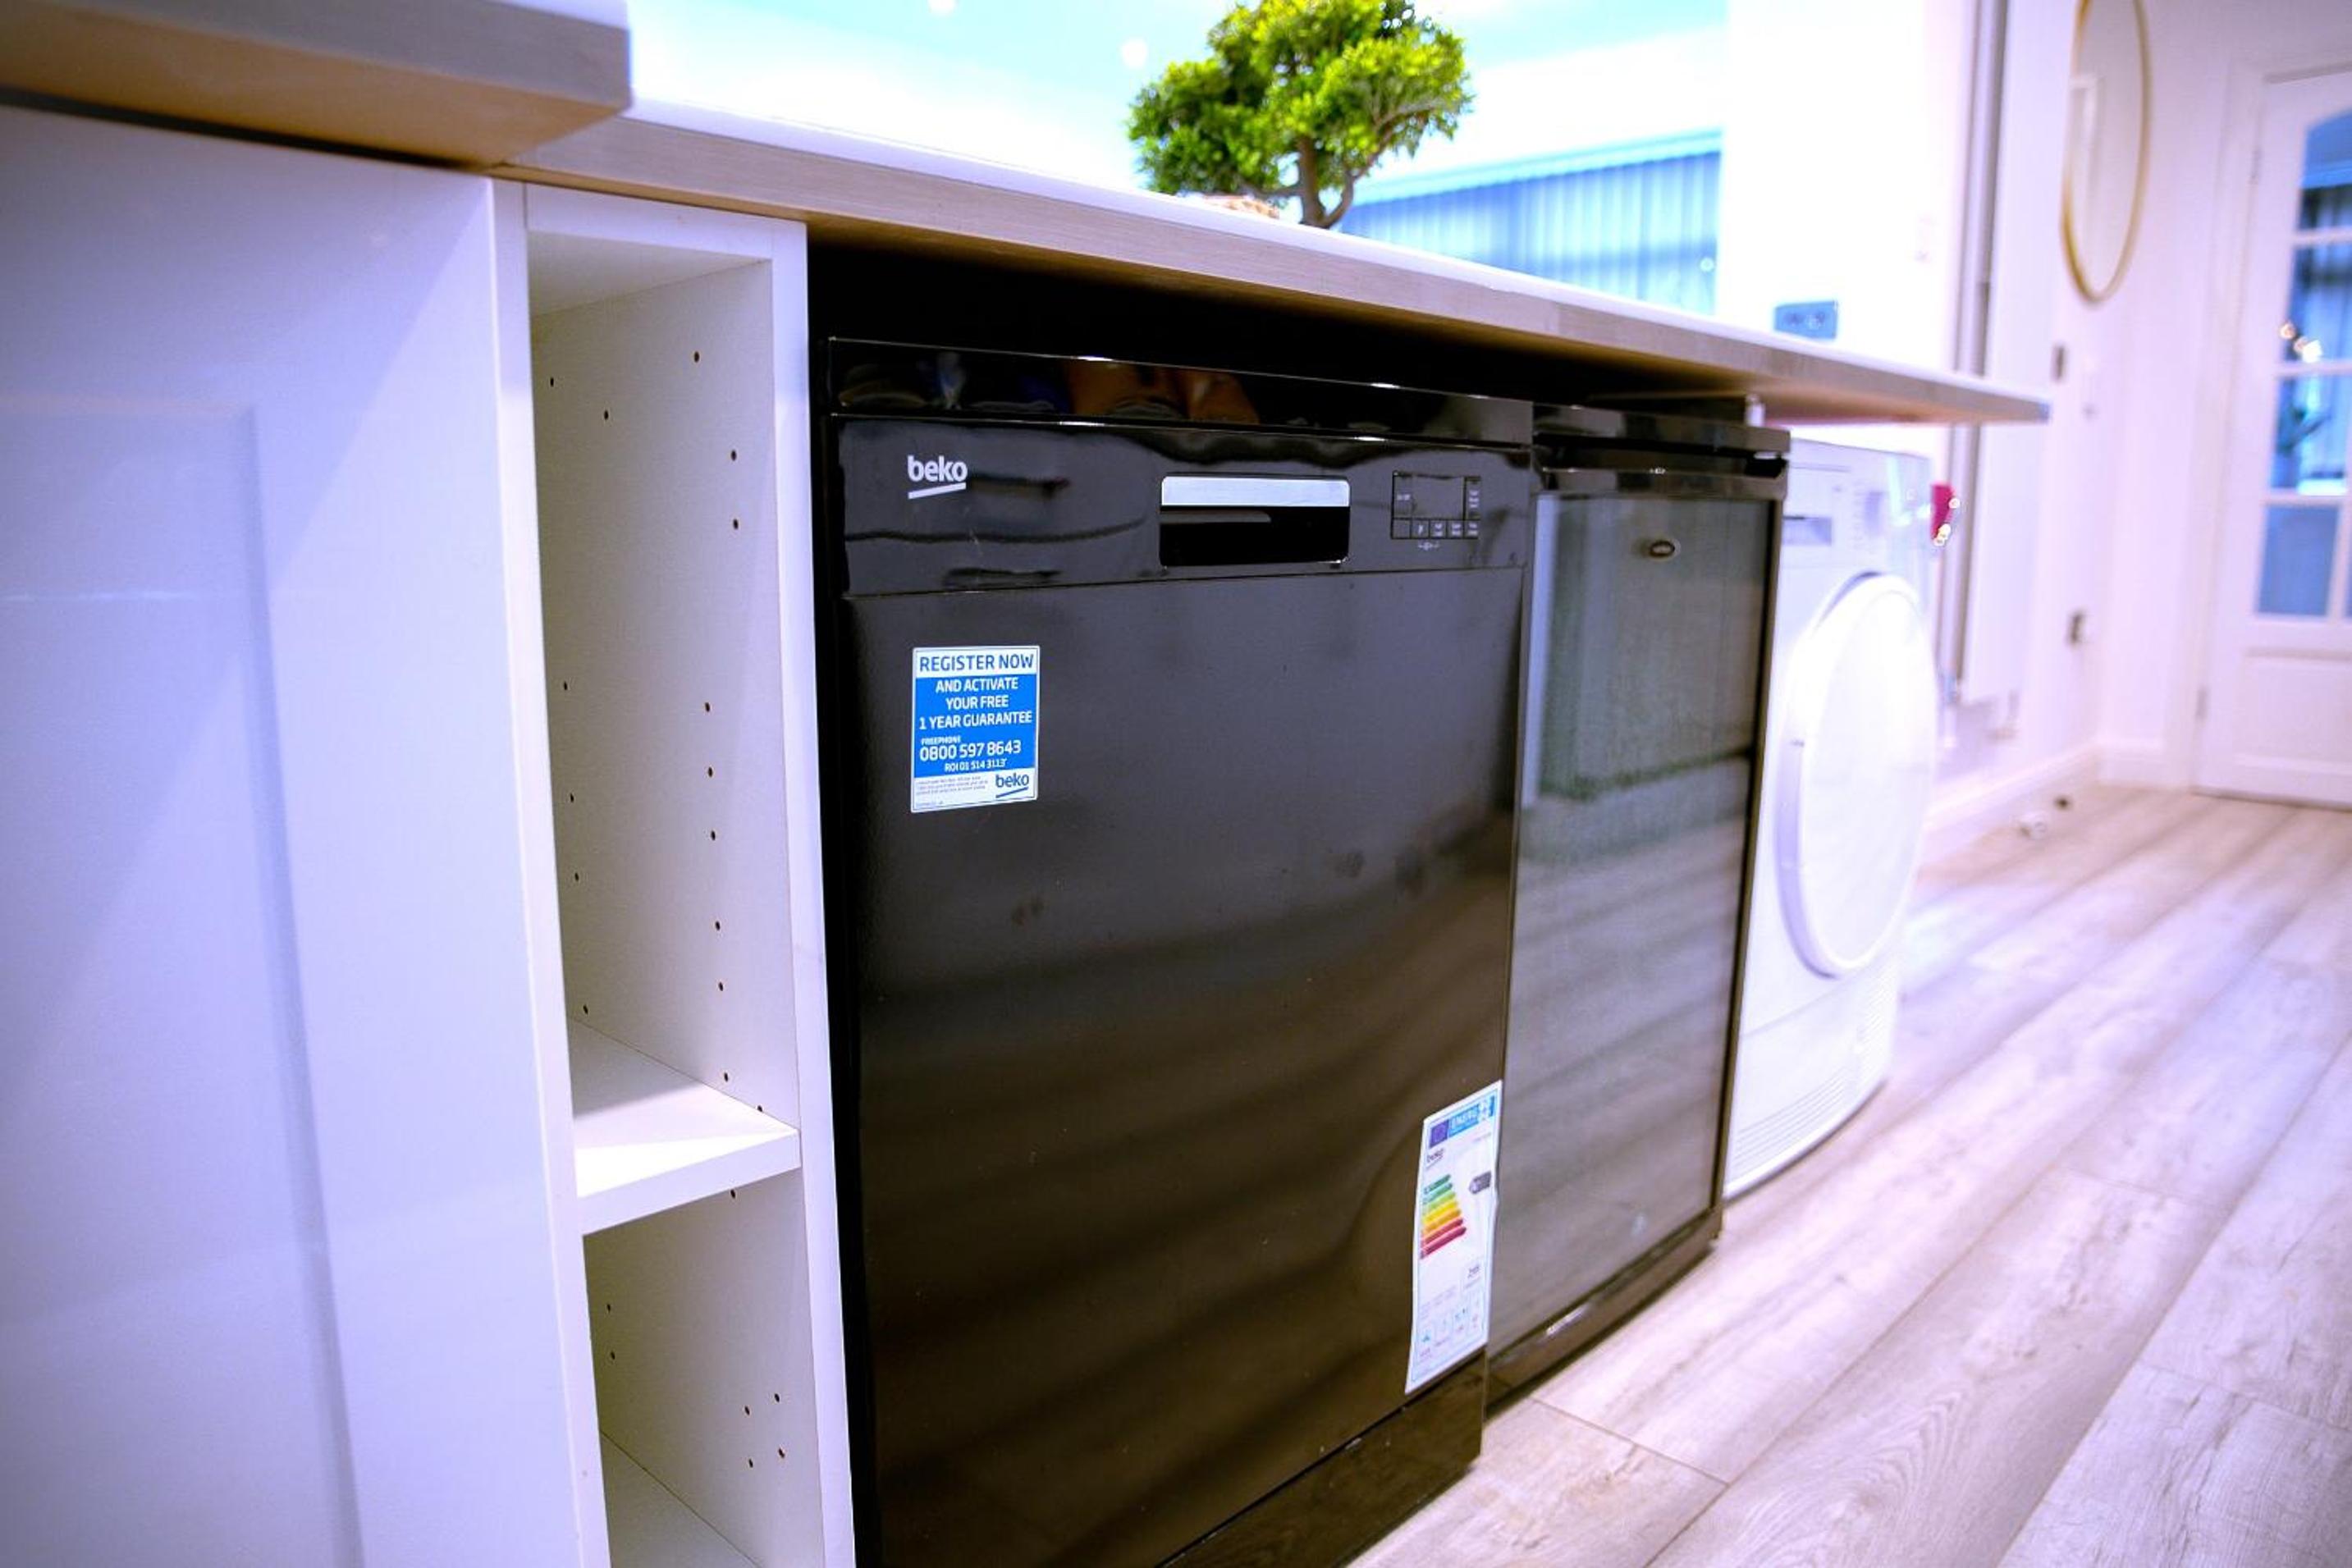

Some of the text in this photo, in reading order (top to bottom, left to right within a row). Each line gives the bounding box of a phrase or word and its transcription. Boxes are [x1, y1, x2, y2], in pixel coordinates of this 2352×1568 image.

[908, 455, 968, 482] beko
[919, 653, 1034, 672] REGISTER NOW
[936, 676, 1019, 693] AND ACTIVATE
[945, 694, 1009, 711] YOUR FREE
[919, 711, 1033, 729] 1 YEAR GUARANTEE
[920, 739, 1022, 761] 0800 597 8643
[995, 772, 1030, 789] beko
